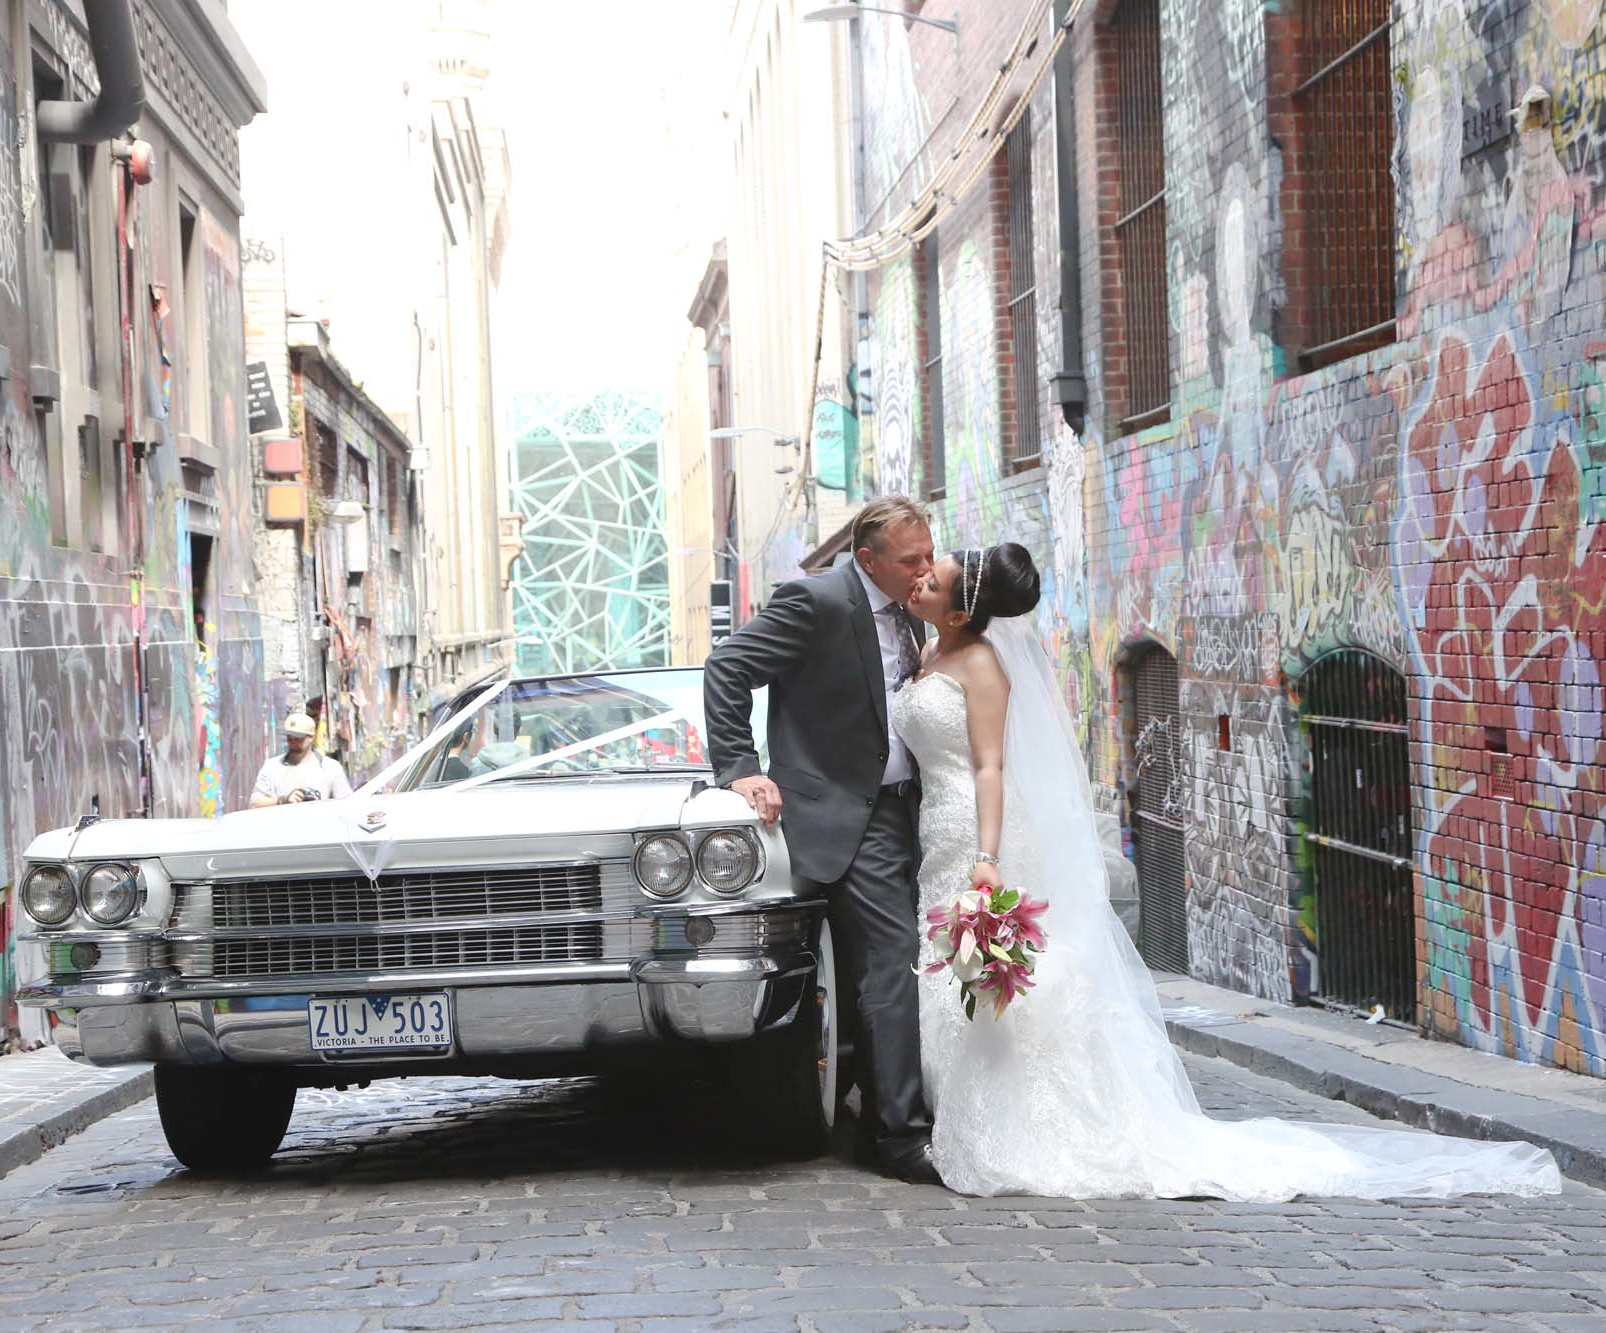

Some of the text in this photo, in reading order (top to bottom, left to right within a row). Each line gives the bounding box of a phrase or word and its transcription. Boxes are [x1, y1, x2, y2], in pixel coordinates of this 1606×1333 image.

[314, 1000, 444, 1037] ZUJ 503
[316, 1037, 357, 1046] VICTORIA
[368, 1036, 385, 1045] THE
[389, 1035, 415, 1044] PLACE
[419, 1035, 431, 1043] TO
[434, 1034, 446, 1043] BE
